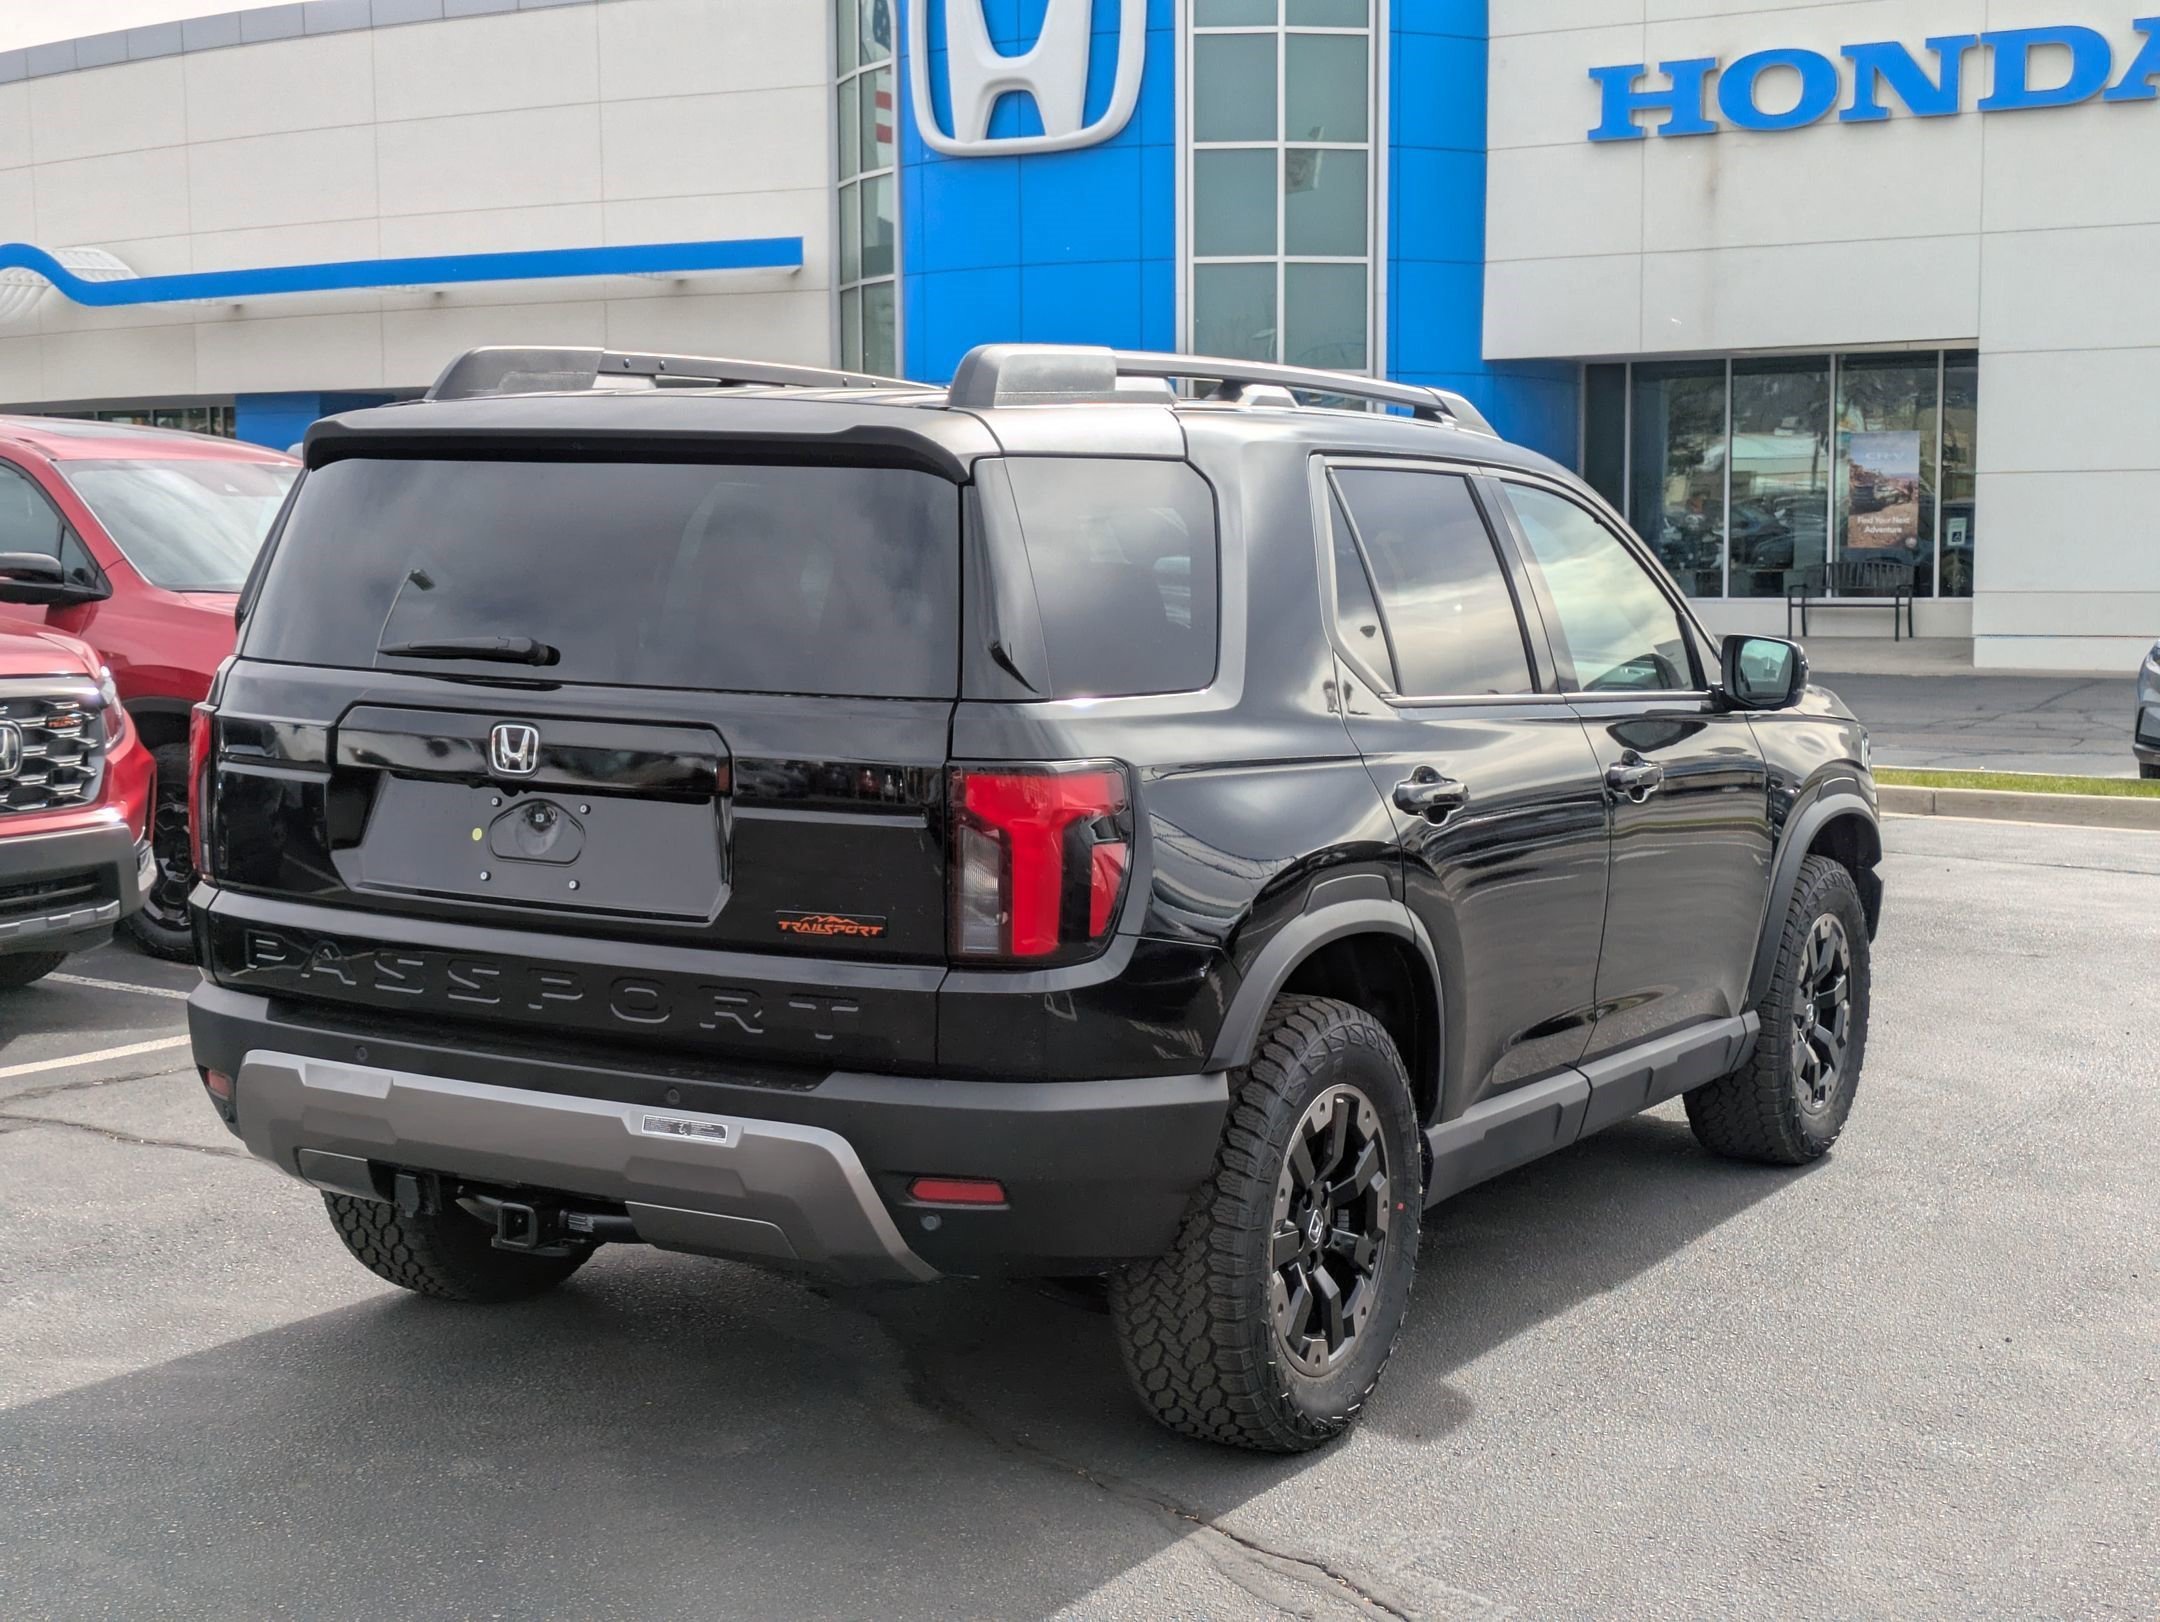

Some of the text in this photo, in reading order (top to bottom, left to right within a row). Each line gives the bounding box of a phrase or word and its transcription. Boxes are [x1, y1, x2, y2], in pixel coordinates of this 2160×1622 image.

[1863, 525, 1903, 534] Adventure
[777, 919, 884, 938] TRAILSPORT
[244, 929, 860, 1040] PASSPORT
